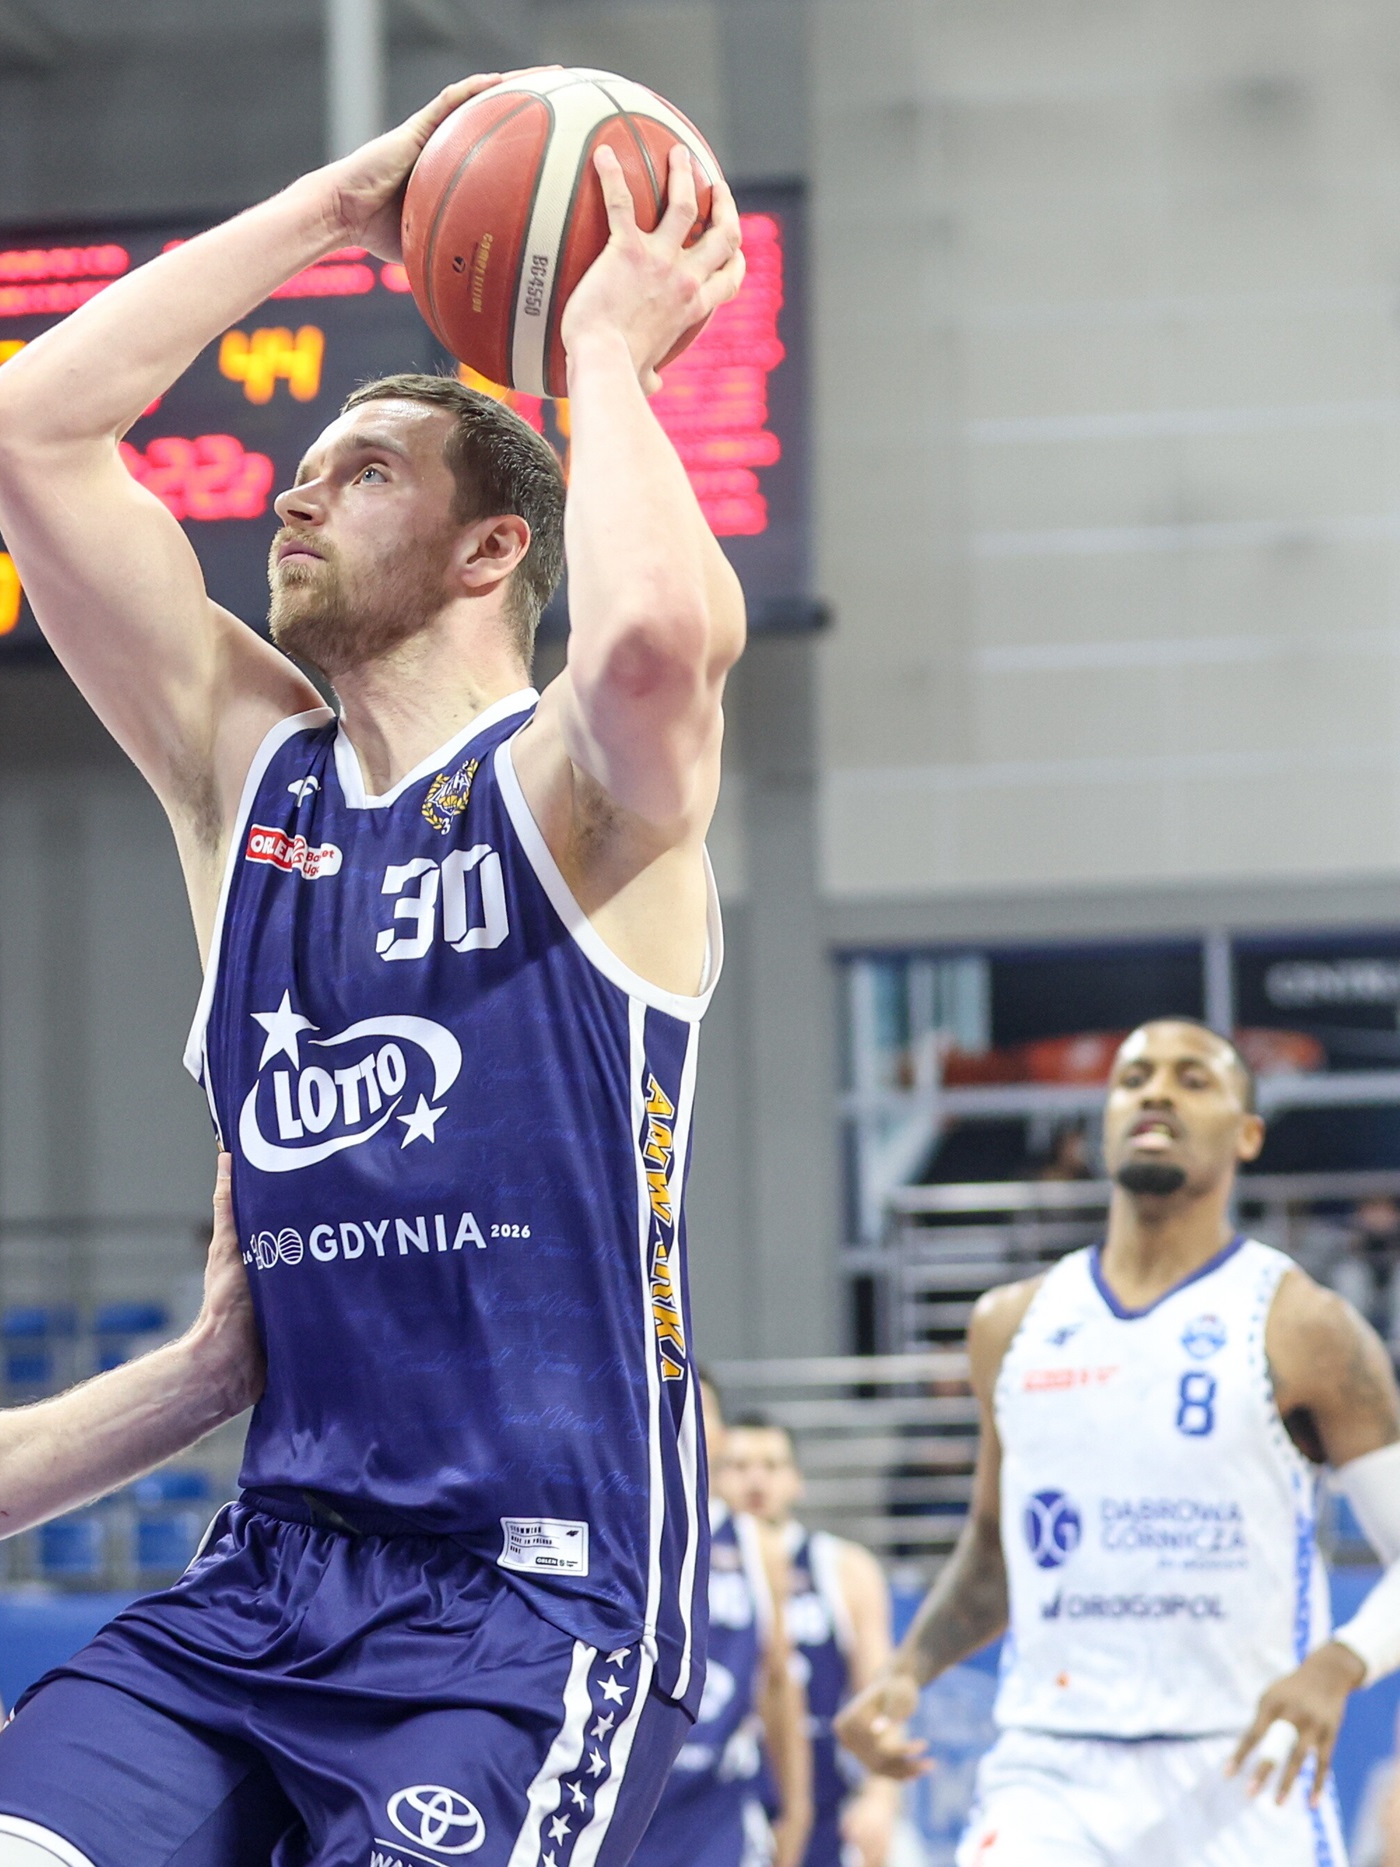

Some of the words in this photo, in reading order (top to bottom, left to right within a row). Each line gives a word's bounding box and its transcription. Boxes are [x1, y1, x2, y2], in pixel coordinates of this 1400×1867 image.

[524, 254, 549, 317] BG4550
[376, 843, 510, 961] 30
[273, 1042, 407, 1140] LOTTO
[309, 1211, 487, 1262] GDYNIA
[490, 1224, 531, 1239] 2026
[1174, 1370, 1217, 1437] 8
